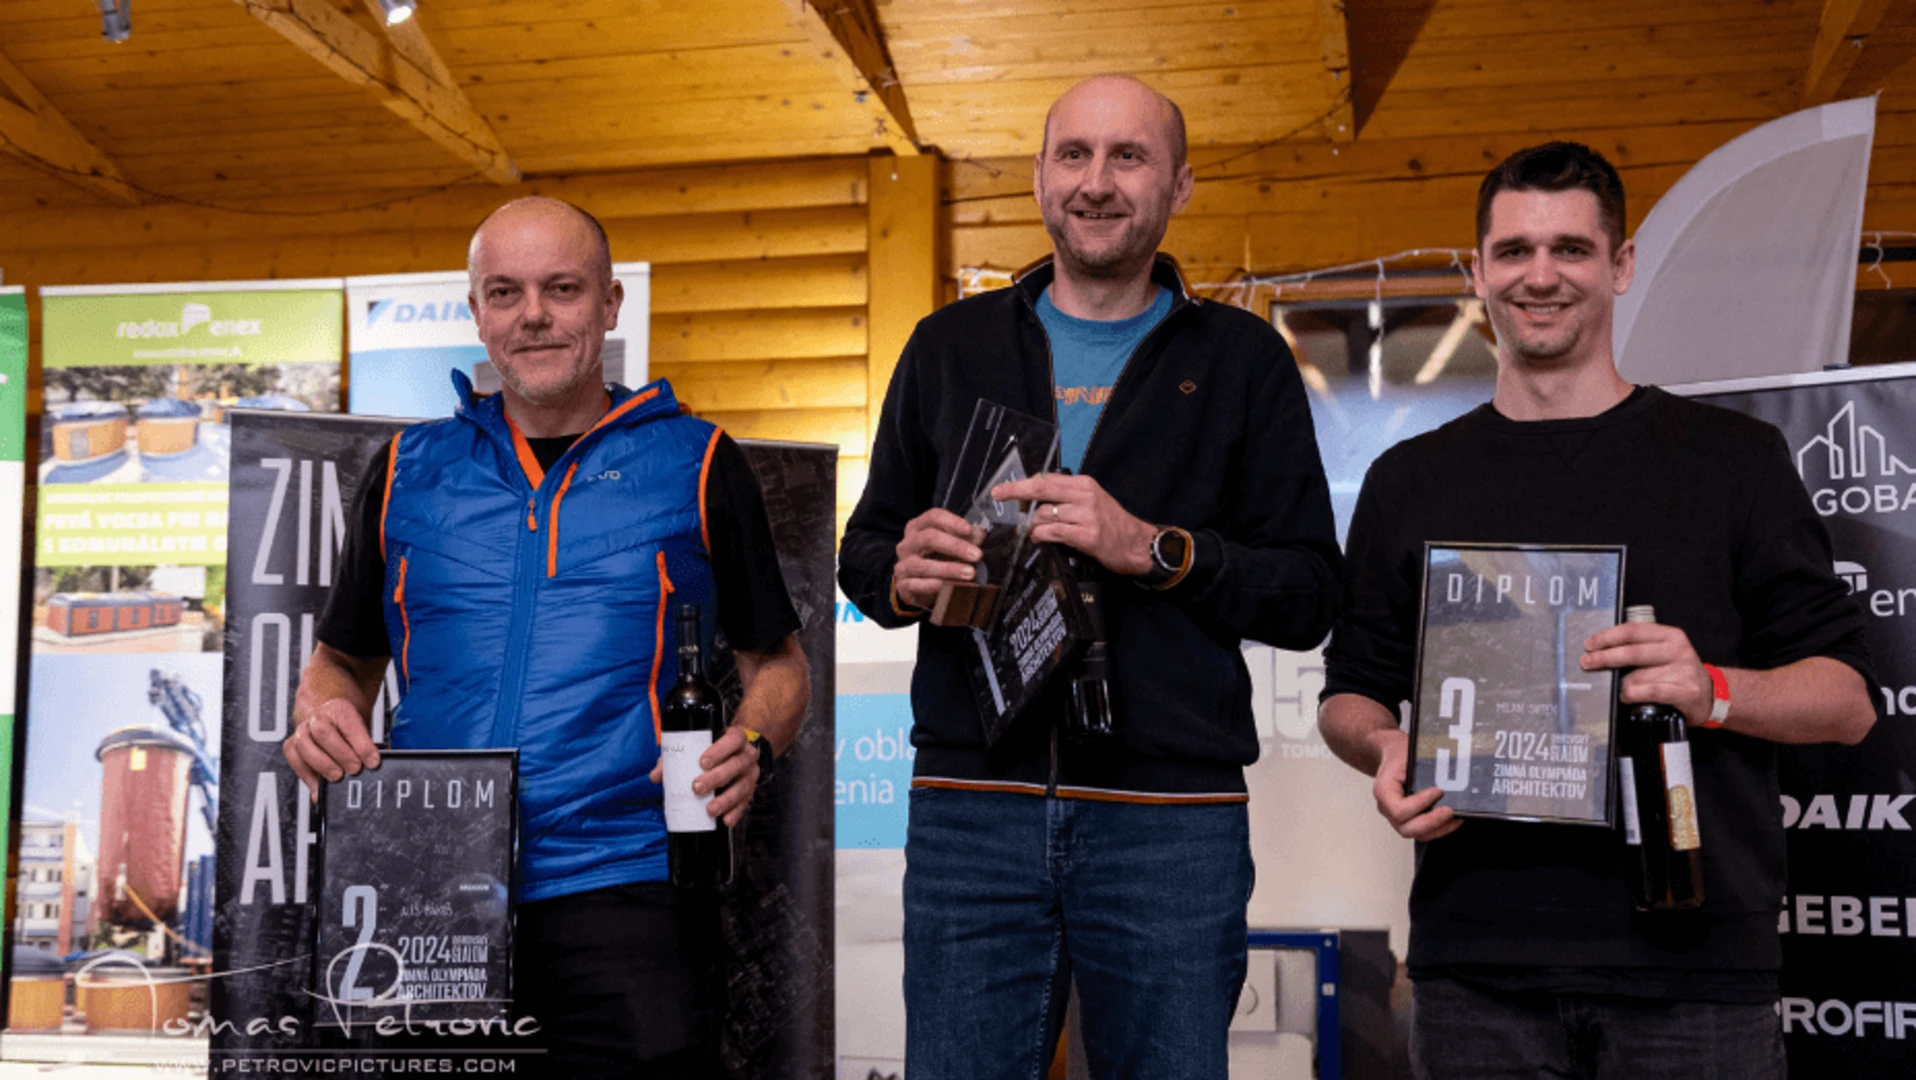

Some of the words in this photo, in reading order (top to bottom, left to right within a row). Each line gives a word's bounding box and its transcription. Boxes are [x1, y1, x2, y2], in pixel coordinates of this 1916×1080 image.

[1447, 573, 1599, 606] DIPLOM
[1495, 731, 1549, 760] 2024
[1493, 763, 1526, 778] ZIMNÁ
[1528, 764, 1587, 781] OLYMPIÁDA
[347, 780, 494, 809] DIPLOM
[1491, 779, 1587, 799] ARCHITEKTOV
[398, 936, 451, 964] 2024
[431, 966, 488, 982] OLYMPIÁDA
[397, 982, 487, 999] ARCHITEKTOV
[1774, 997, 1916, 1039] ROFIR
